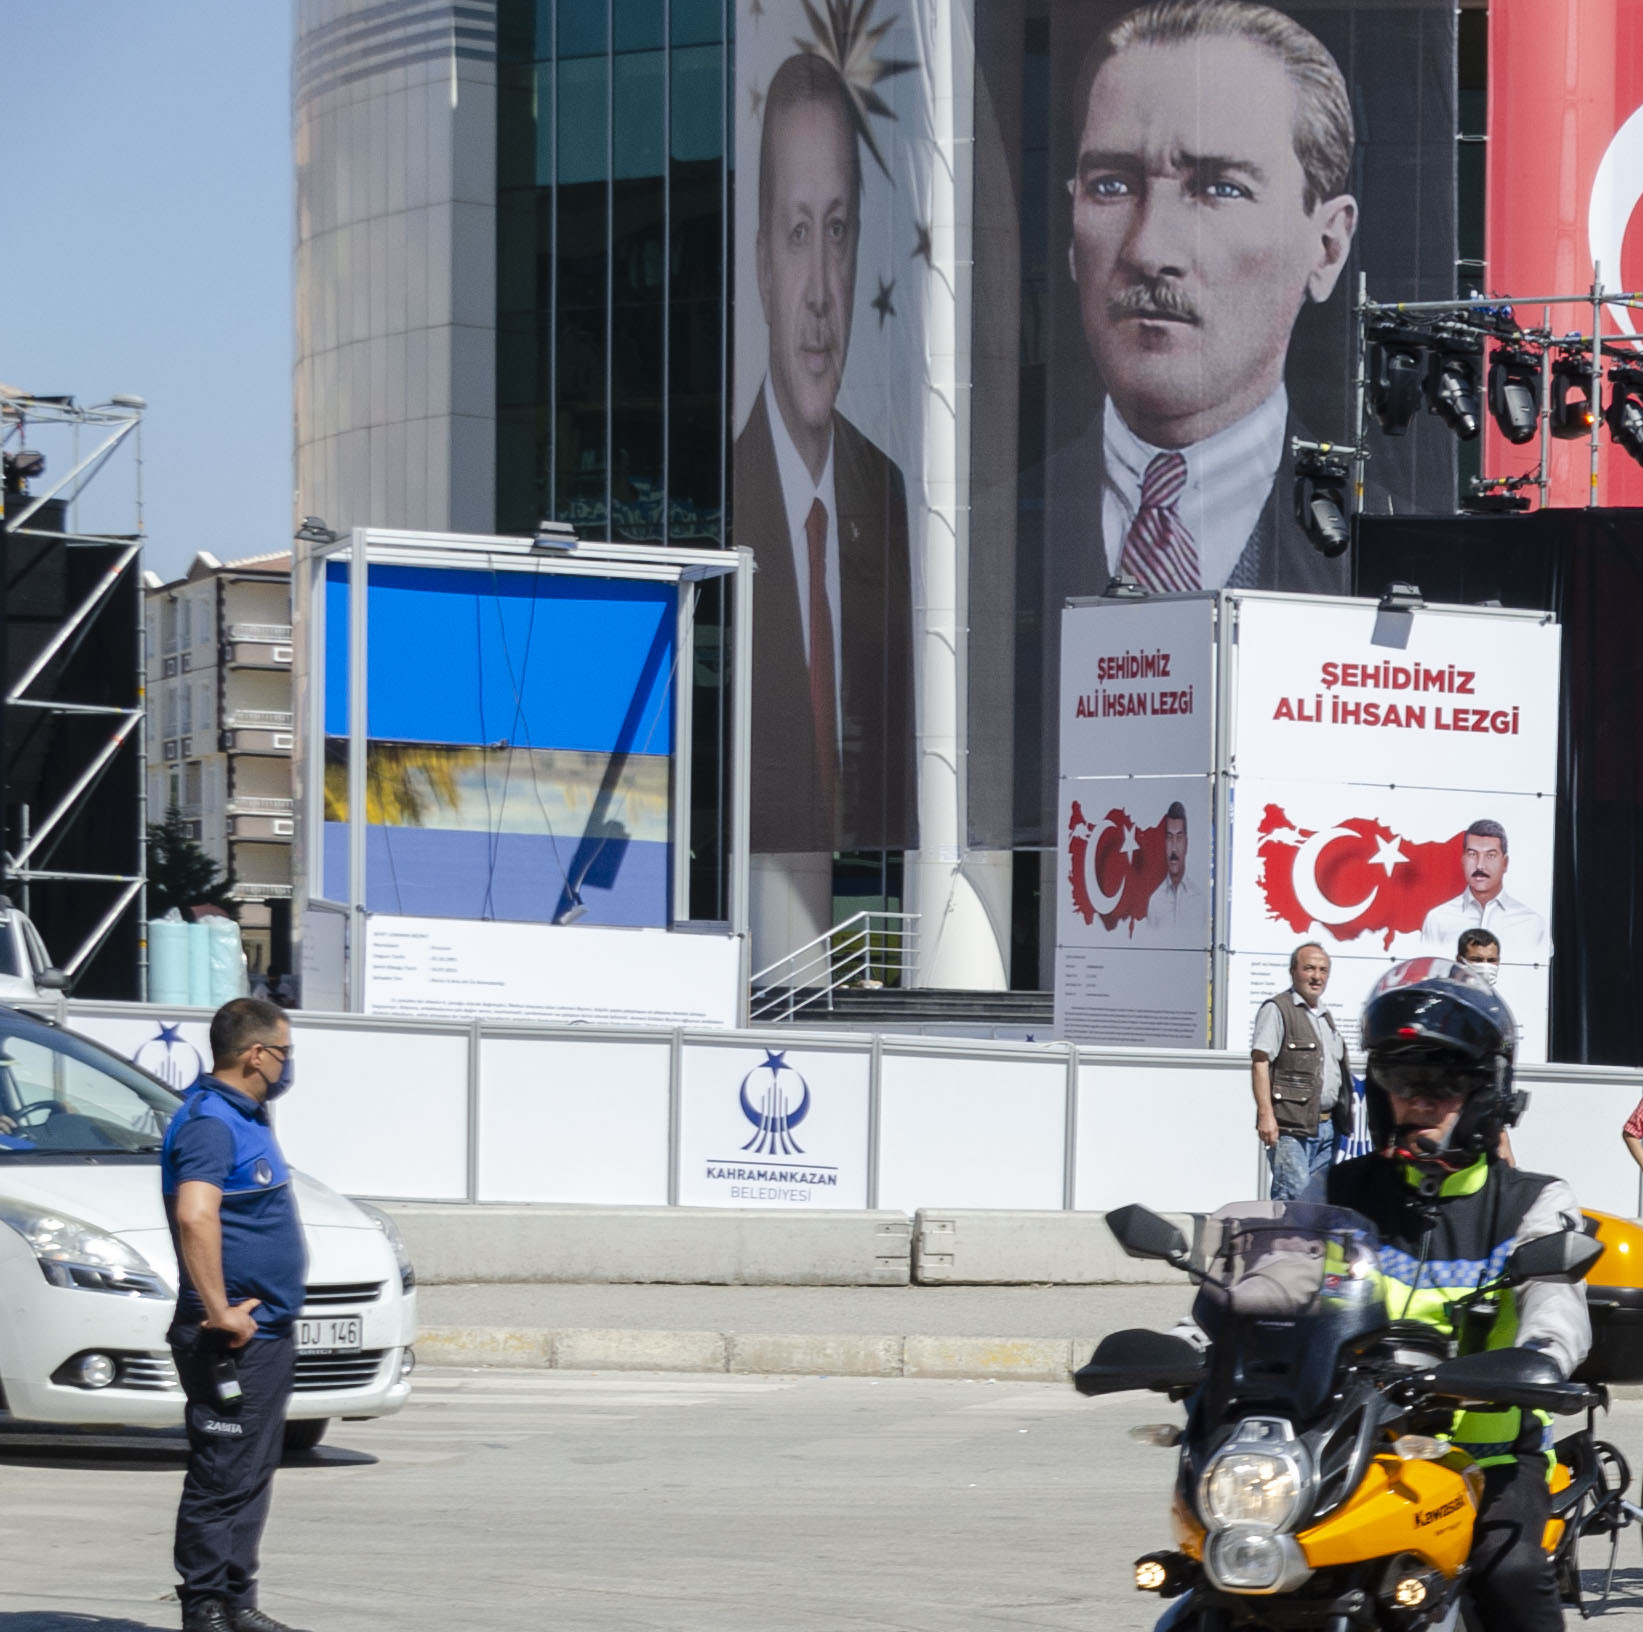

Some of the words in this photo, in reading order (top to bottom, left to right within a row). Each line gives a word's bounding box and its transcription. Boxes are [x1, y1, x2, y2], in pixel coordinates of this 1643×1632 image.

[1097, 648, 1170, 684] ŞEHİDİMİZ
[1320, 660, 1475, 695] ŞEHİDİMİZ
[1076, 685, 1098, 718] ALİ
[1102, 688, 1147, 716] İHSAN
[1152, 685, 1193, 714] LEZGİ
[1273, 693, 1322, 722] ALİ
[1332, 694, 1424, 729] İHSAN
[1436, 705, 1519, 735] LEZGİ
[706, 1167, 838, 1186] KAHRAMANKAZAN
[731, 1186, 811, 1201] BELEDİYESİ
[301, 1322, 321, 1345] DJ
[331, 1321, 357, 1344] 146
[1414, 1494, 1465, 1529] Kawasaki
